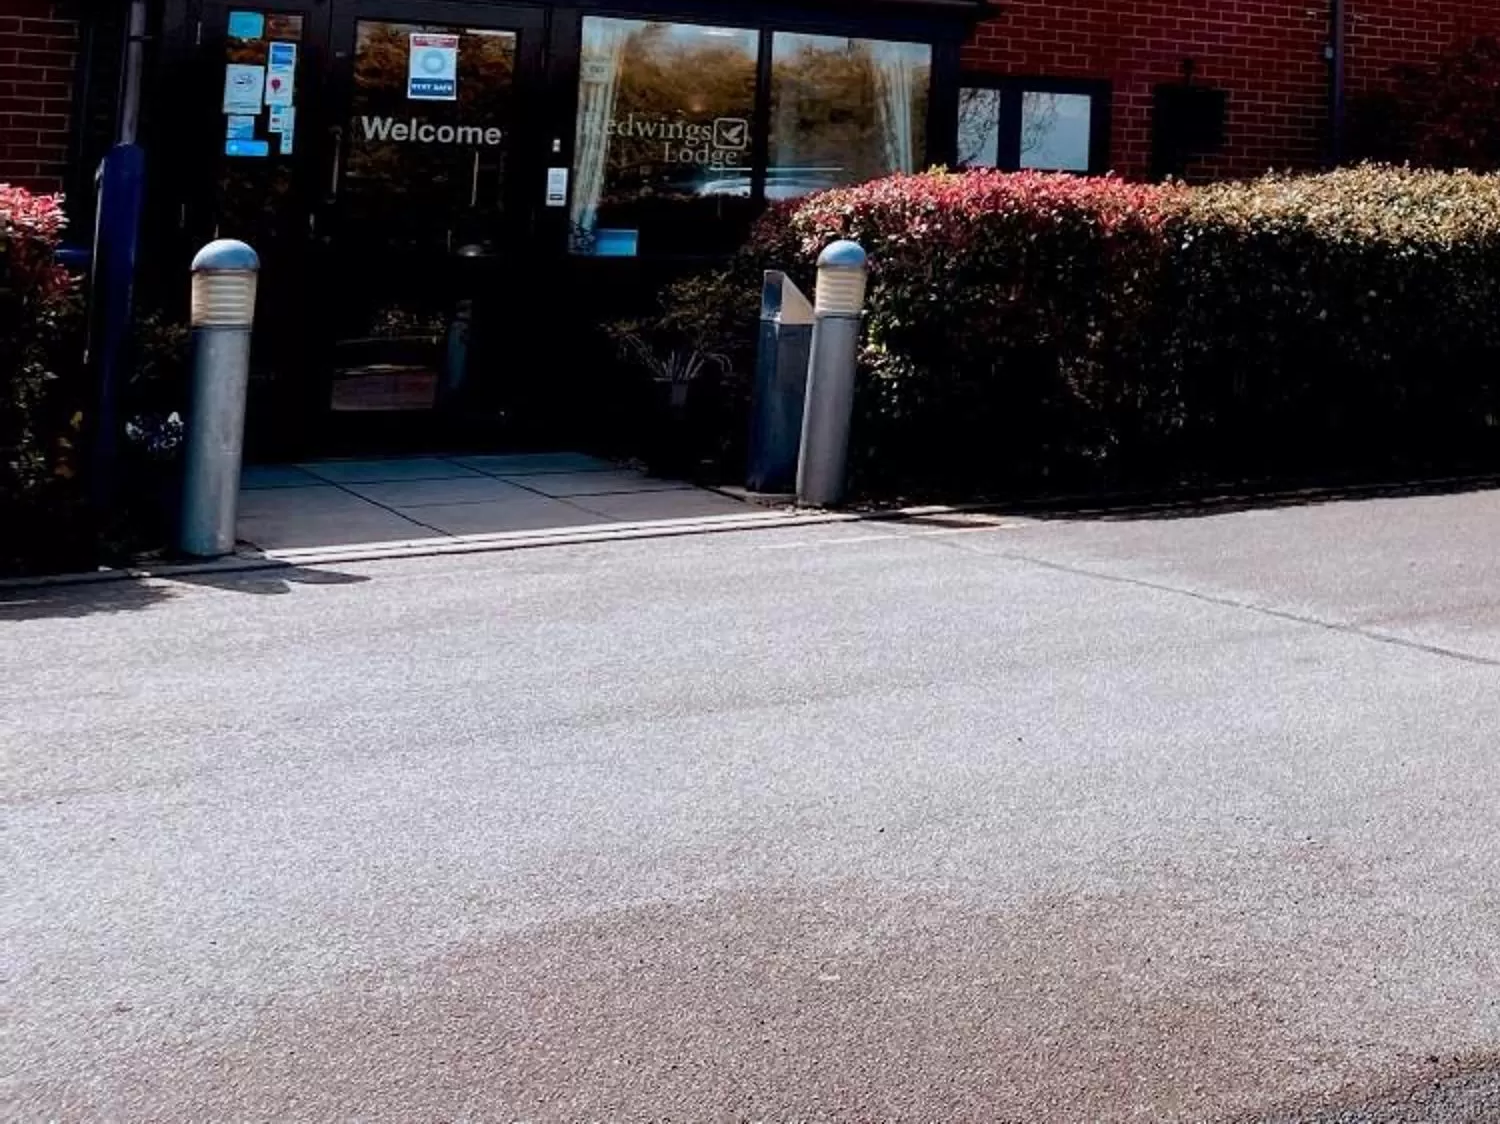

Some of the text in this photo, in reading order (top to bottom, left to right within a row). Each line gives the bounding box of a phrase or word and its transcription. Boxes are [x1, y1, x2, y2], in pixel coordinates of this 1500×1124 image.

[361, 115, 502, 145] Welcome
[583, 112, 713, 147] edwings
[663, 141, 738, 168] Lodge
